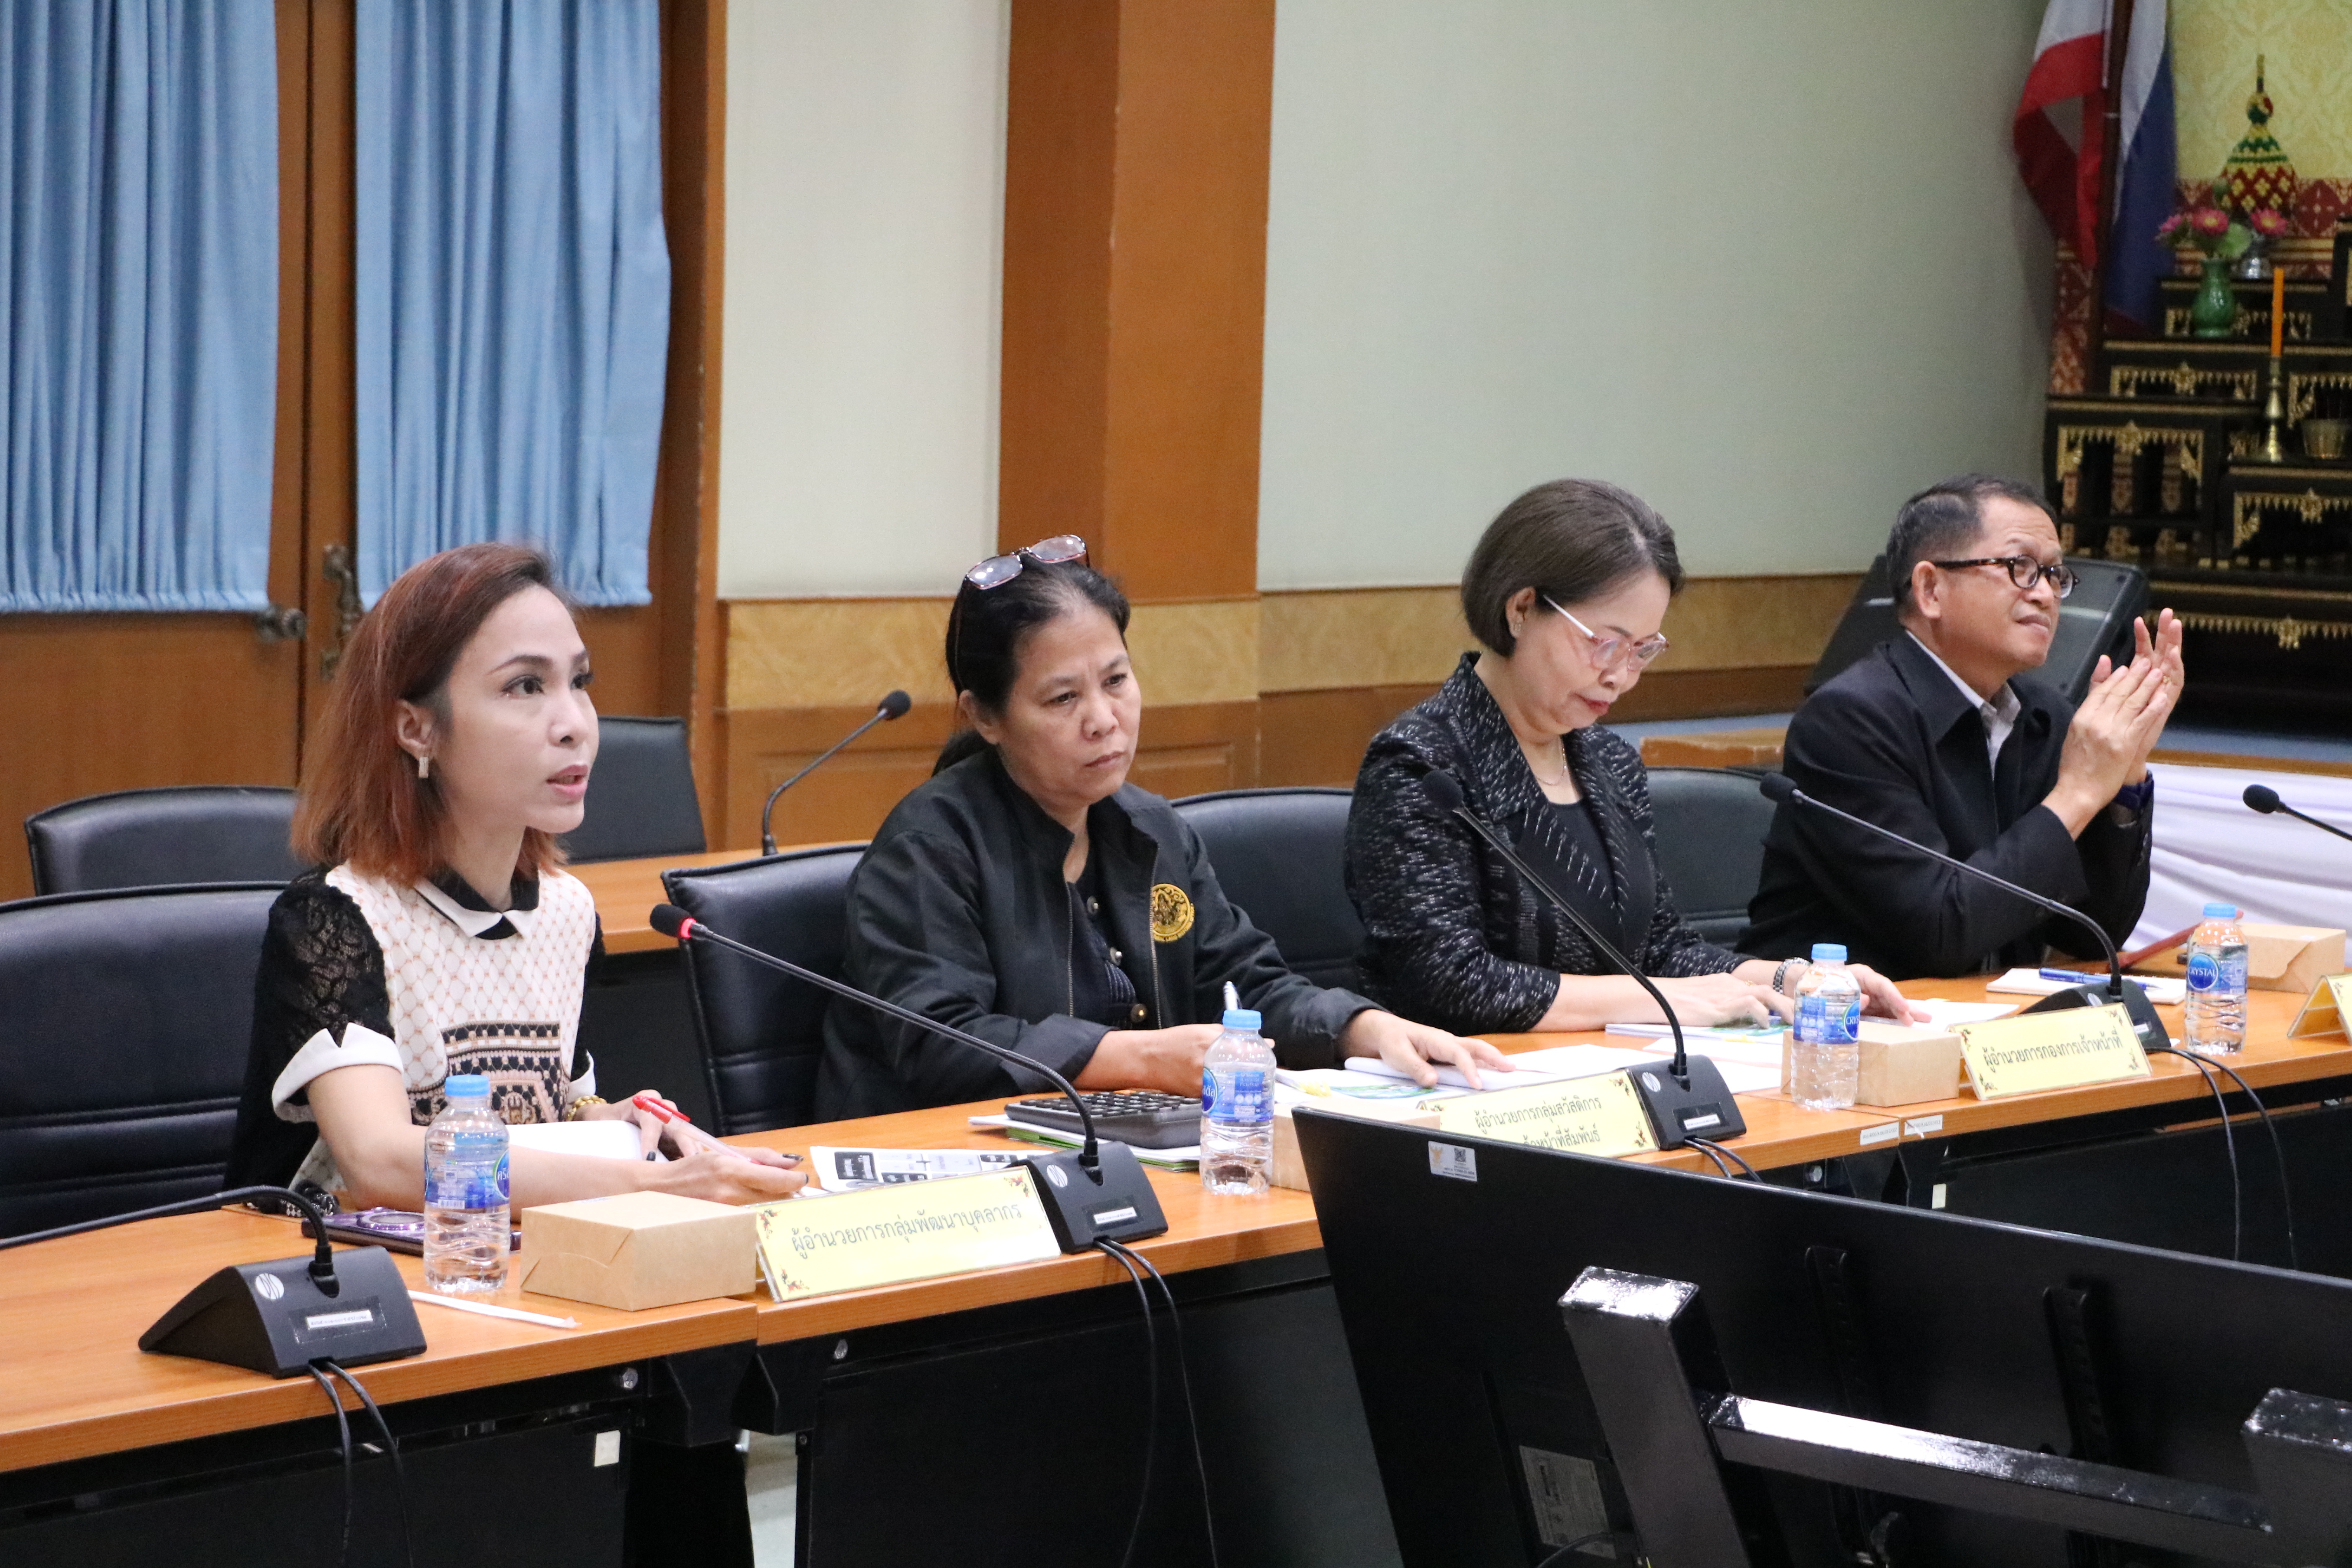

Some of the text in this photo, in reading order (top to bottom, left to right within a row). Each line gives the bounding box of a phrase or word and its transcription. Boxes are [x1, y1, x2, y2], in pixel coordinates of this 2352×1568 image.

[1982, 1025, 2124, 1073] ผู้อำนวยการกองการเจ้าหน้าที่
[1474, 1095, 1602, 1135] ผู้อำนวยการกลุ่มสวัสดิการ
[791, 1203, 1023, 1260] ผู้อำนวยการกลุ่มพัฒนาบุคลากร
